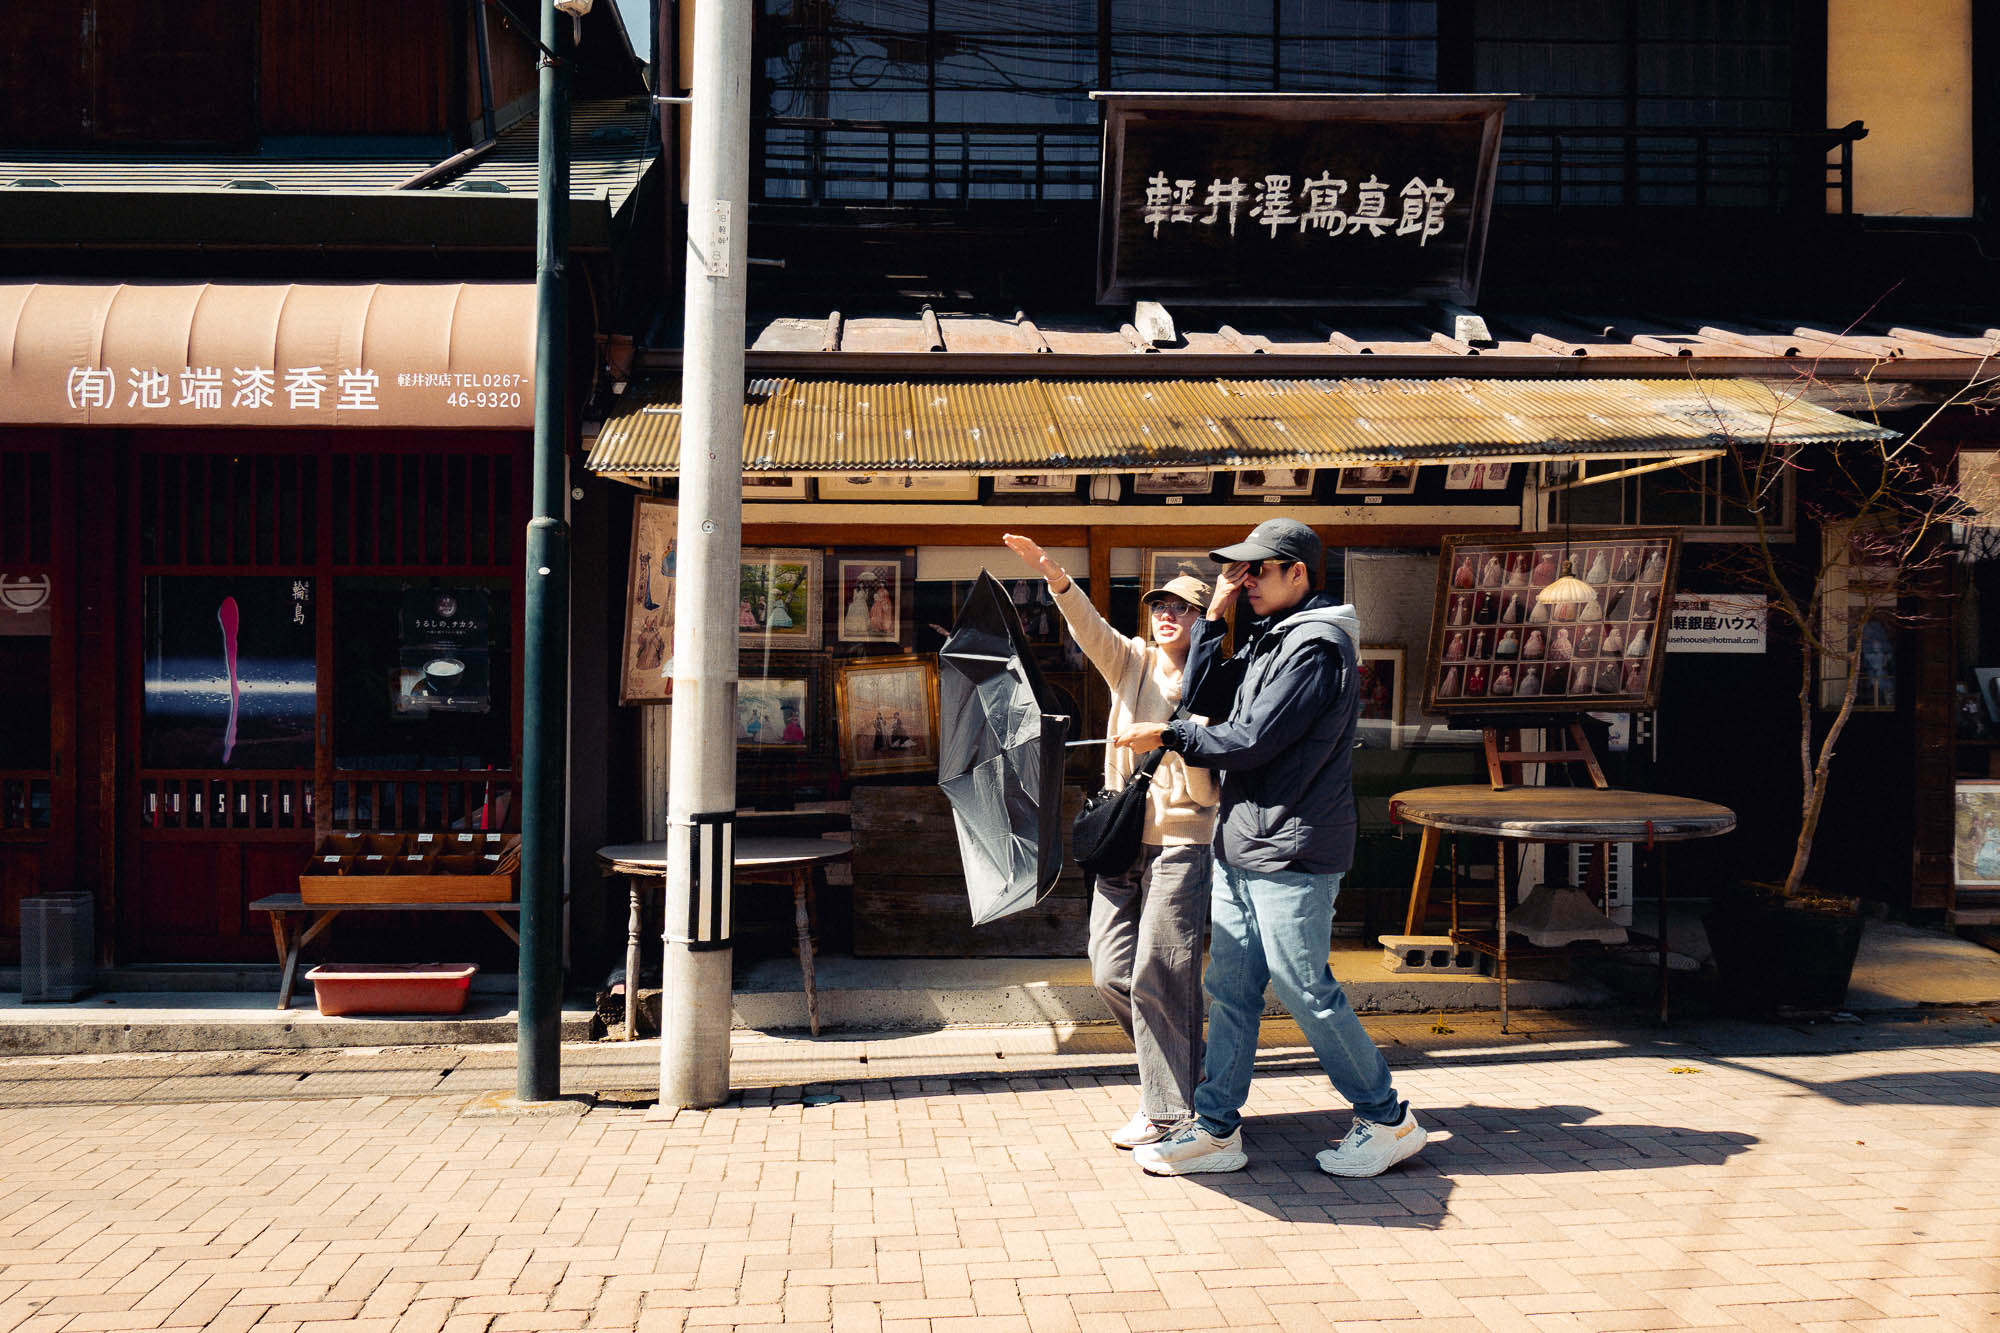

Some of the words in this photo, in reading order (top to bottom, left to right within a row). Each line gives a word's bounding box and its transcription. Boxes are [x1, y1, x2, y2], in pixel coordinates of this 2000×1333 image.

[397, 373, 452, 388] 軽井沢店
[447, 392, 522, 408] 46-9320
[291, 579, 306, 626] 輪島
[1670, 616, 1759, 630] 軽銀座ハウス
